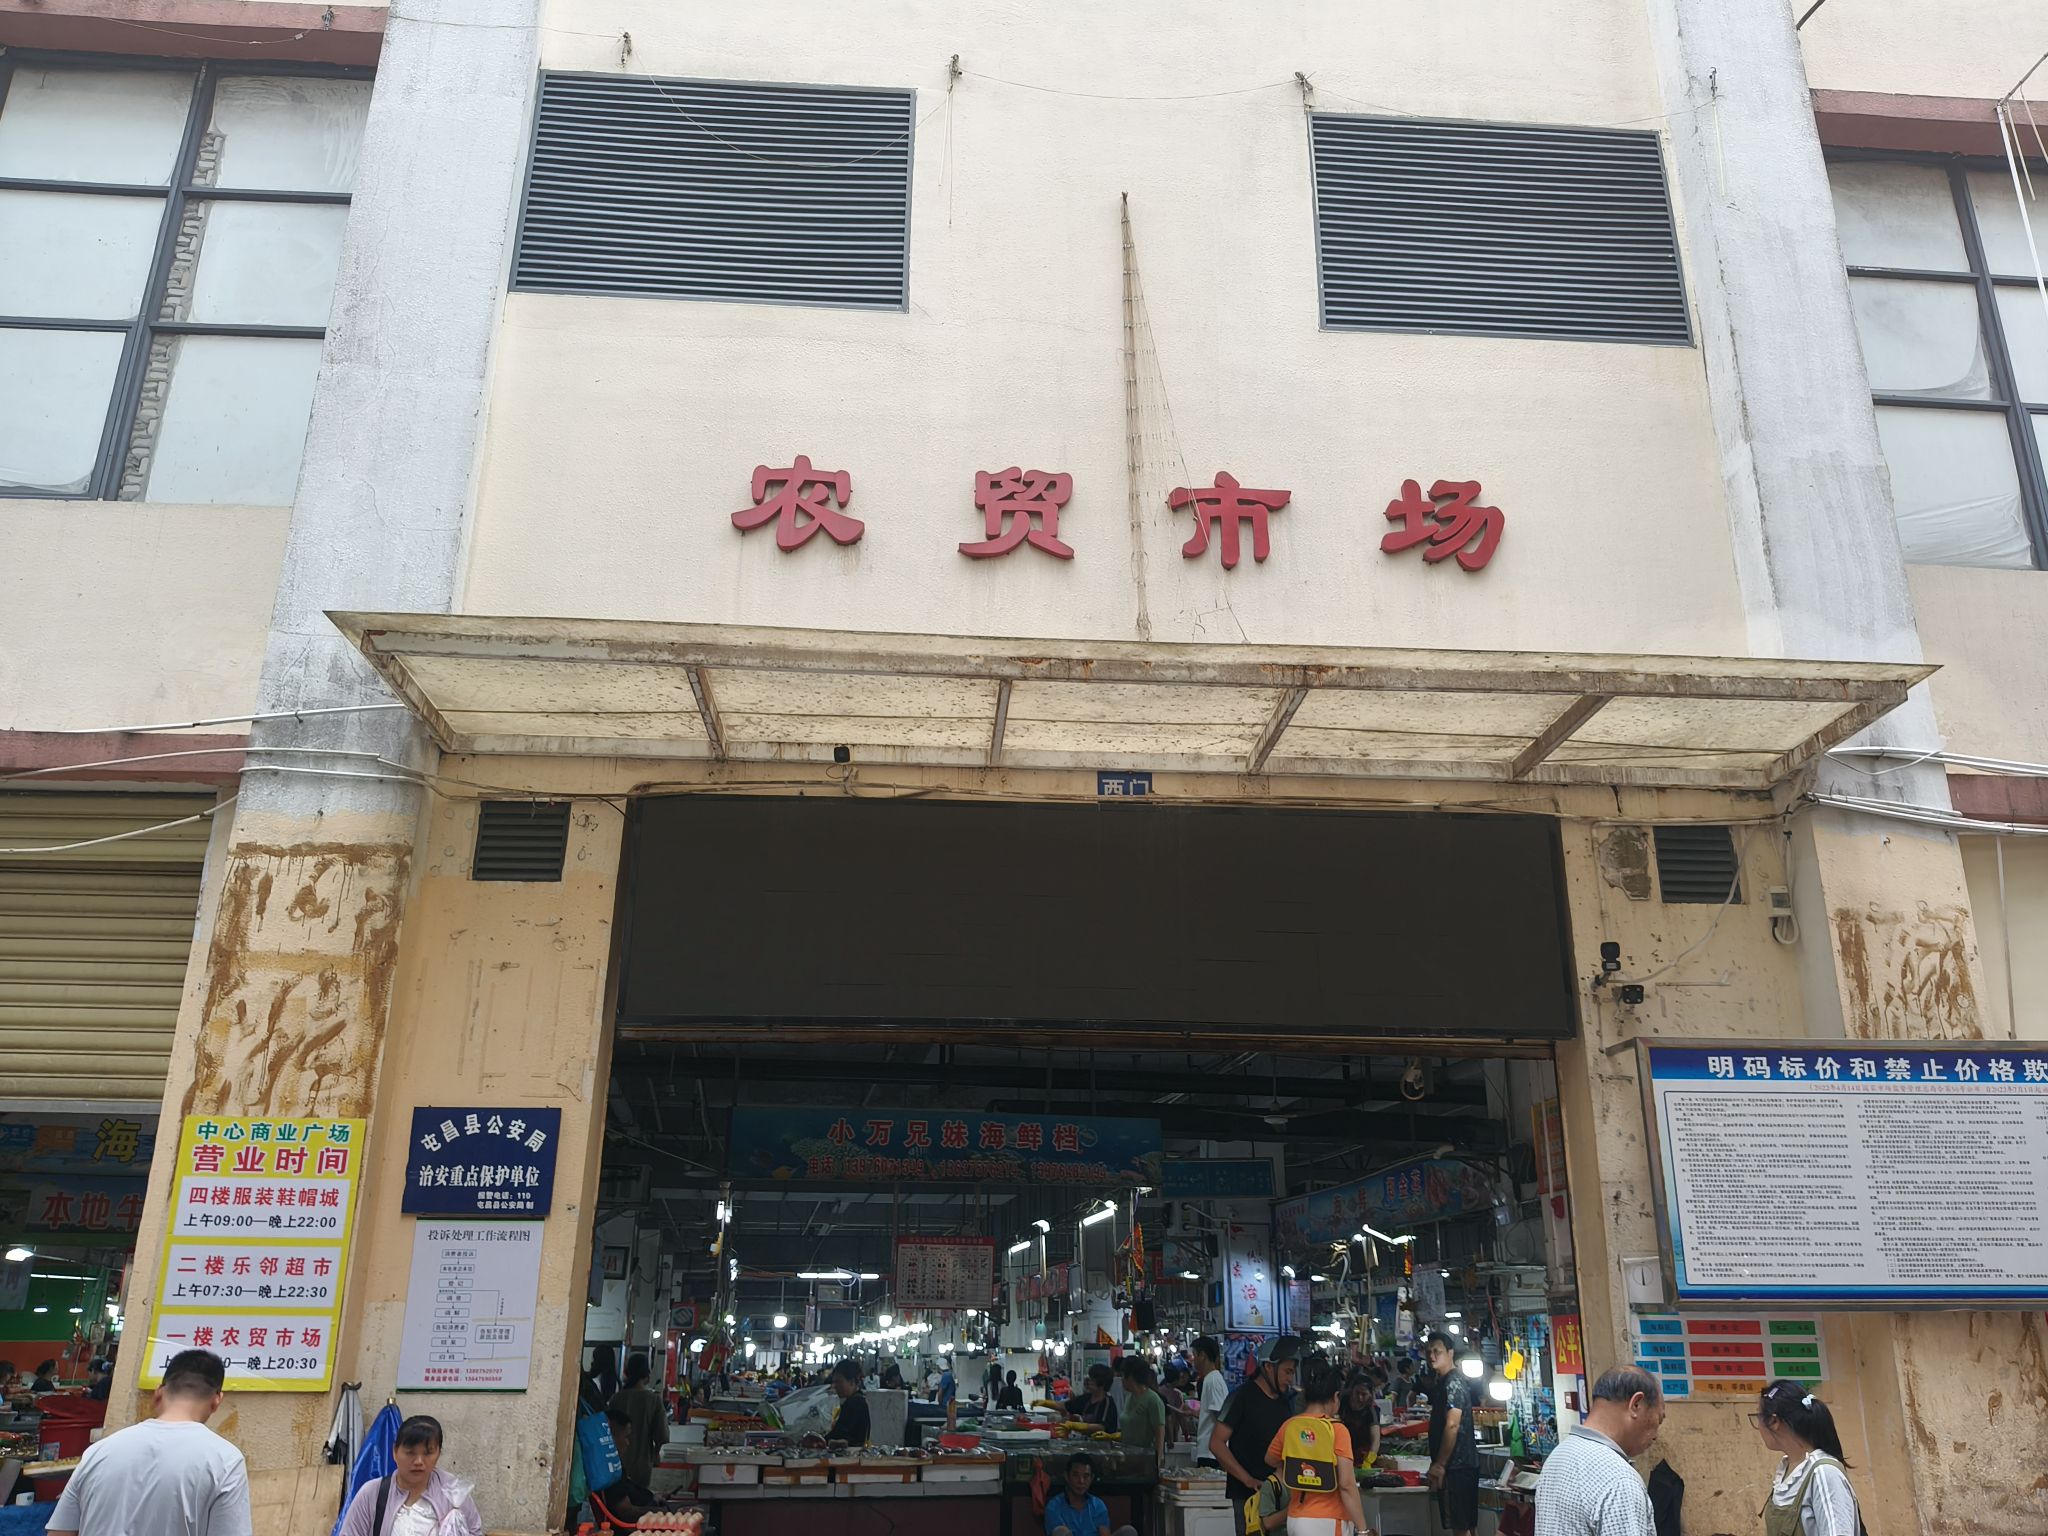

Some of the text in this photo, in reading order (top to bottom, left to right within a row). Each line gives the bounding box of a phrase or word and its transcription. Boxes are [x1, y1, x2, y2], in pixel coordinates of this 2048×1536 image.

[731, 455, 1505, 572] 农贸市场
[1102, 779, 1149, 795] 西门
[1707, 1056, 2048, 1081] 明码标价和禁止价格欺
[92, 1119, 141, 1162] 海
[197, 1121, 351, 1143] 中心商业广场
[420, 1113, 547, 1152] 屯昌县公安局
[827, 1117, 1079, 1151] 小万兄妹海鲜档
[192, 1144, 349, 1175] 营业时间
[419, 1165, 540, 1187] 治安重点保护单位
[189, 1186, 340, 1207] 四楼服装鞋帽城
[428, 1229, 531, 1242] 投诉处理工作流程图
[177, 1255, 332, 1277] 二楼乐邻超市
[166, 1326, 321, 1348] 一楼农贸市场
[1556, 1324, 1583, 1366] 公平
